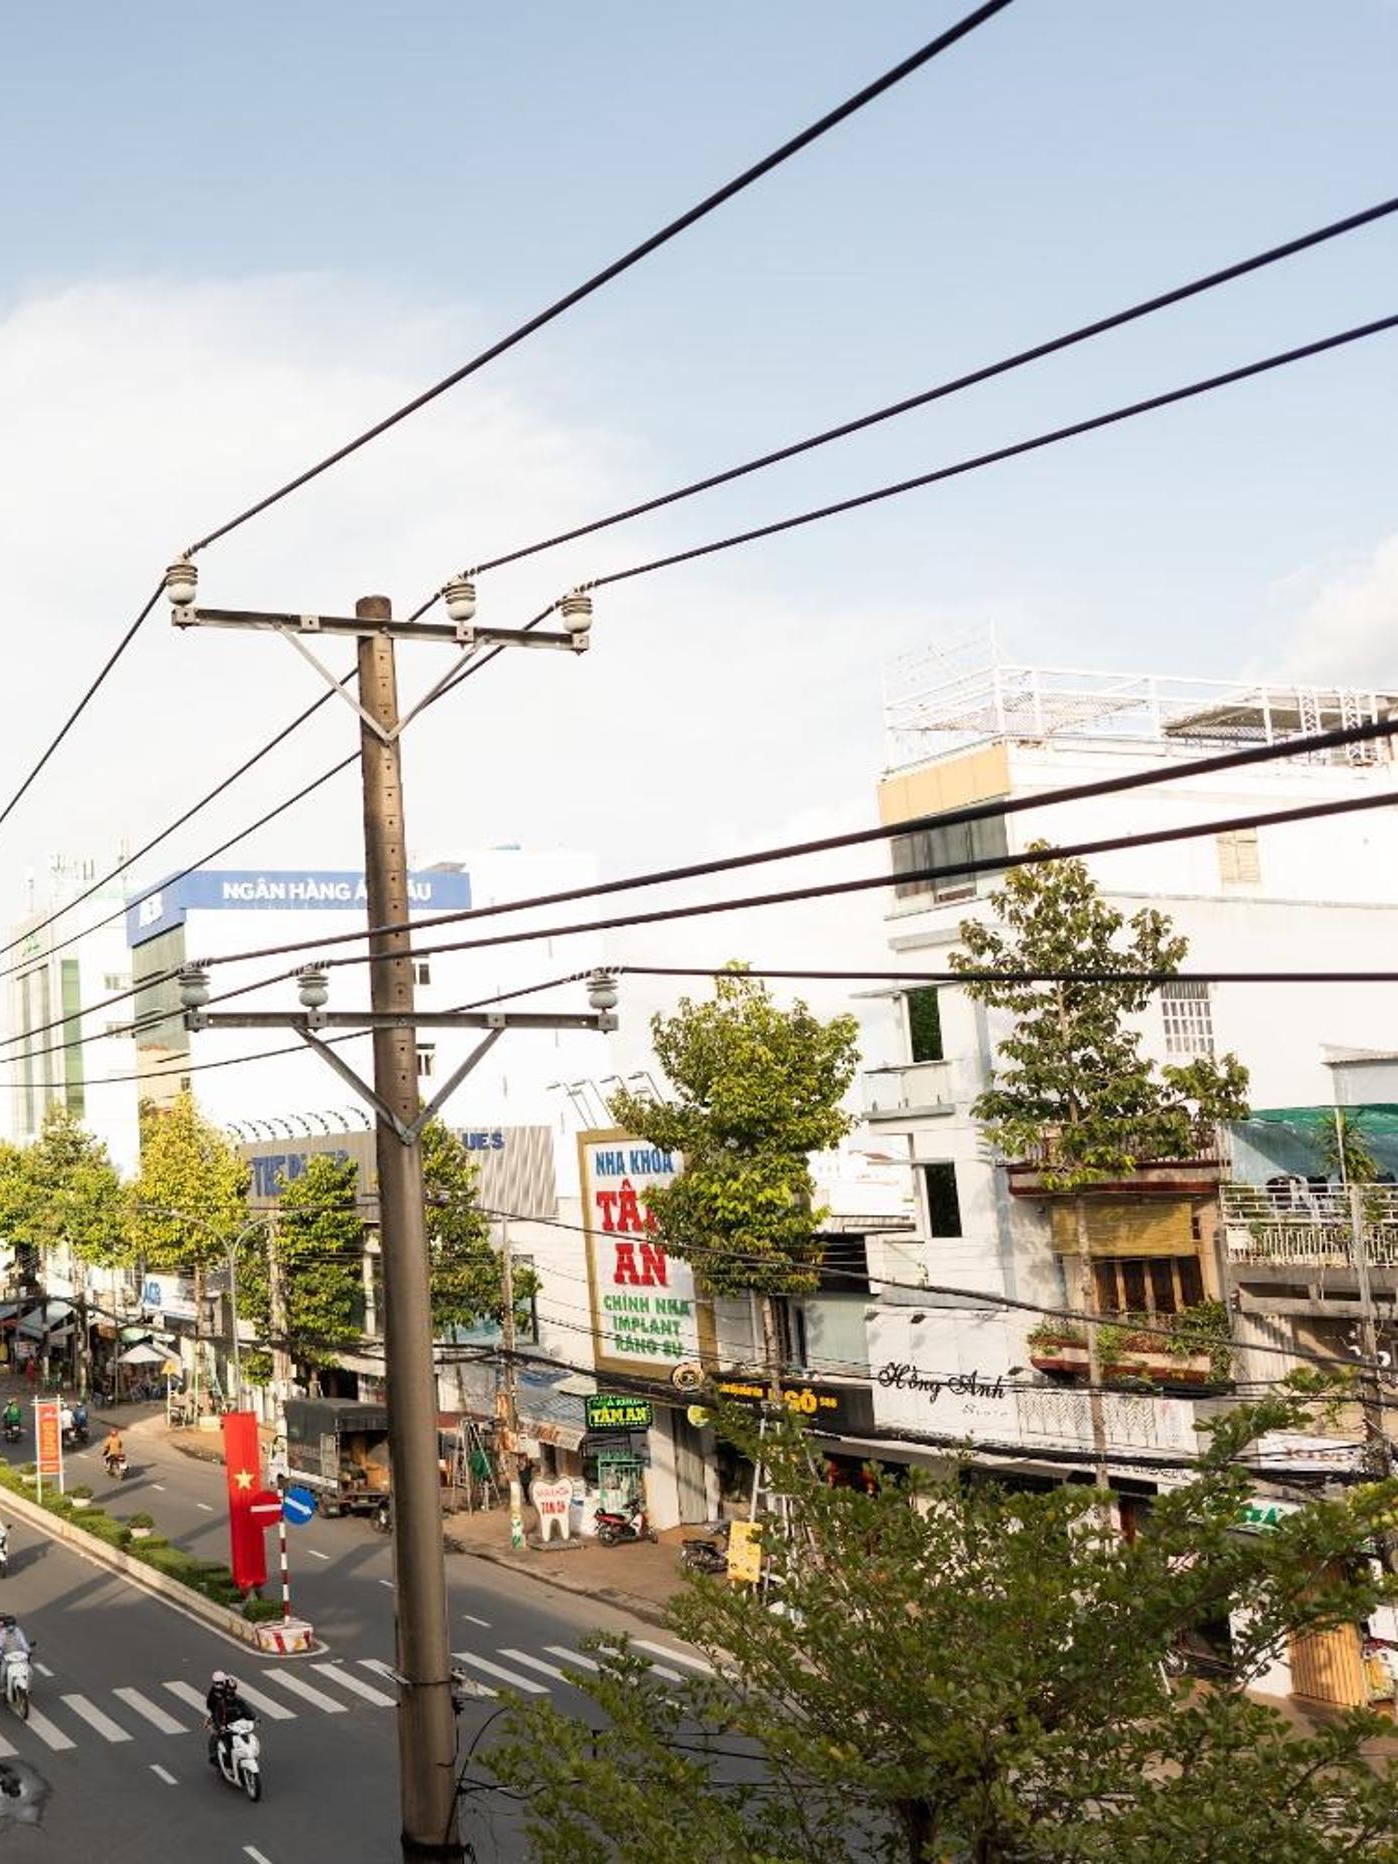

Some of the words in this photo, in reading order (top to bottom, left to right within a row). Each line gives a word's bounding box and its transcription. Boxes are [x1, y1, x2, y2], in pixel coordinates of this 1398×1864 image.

[223, 877, 285, 900] NGÂN
[289, 877, 350, 900] HÀNG
[596, 1151, 625, 1176] NHA
[629, 1149, 674, 1174] KHOA
[614, 1243, 667, 1286] AN
[656, 1297, 690, 1316] NHA
[613, 1316, 680, 1335] IMPLANT
